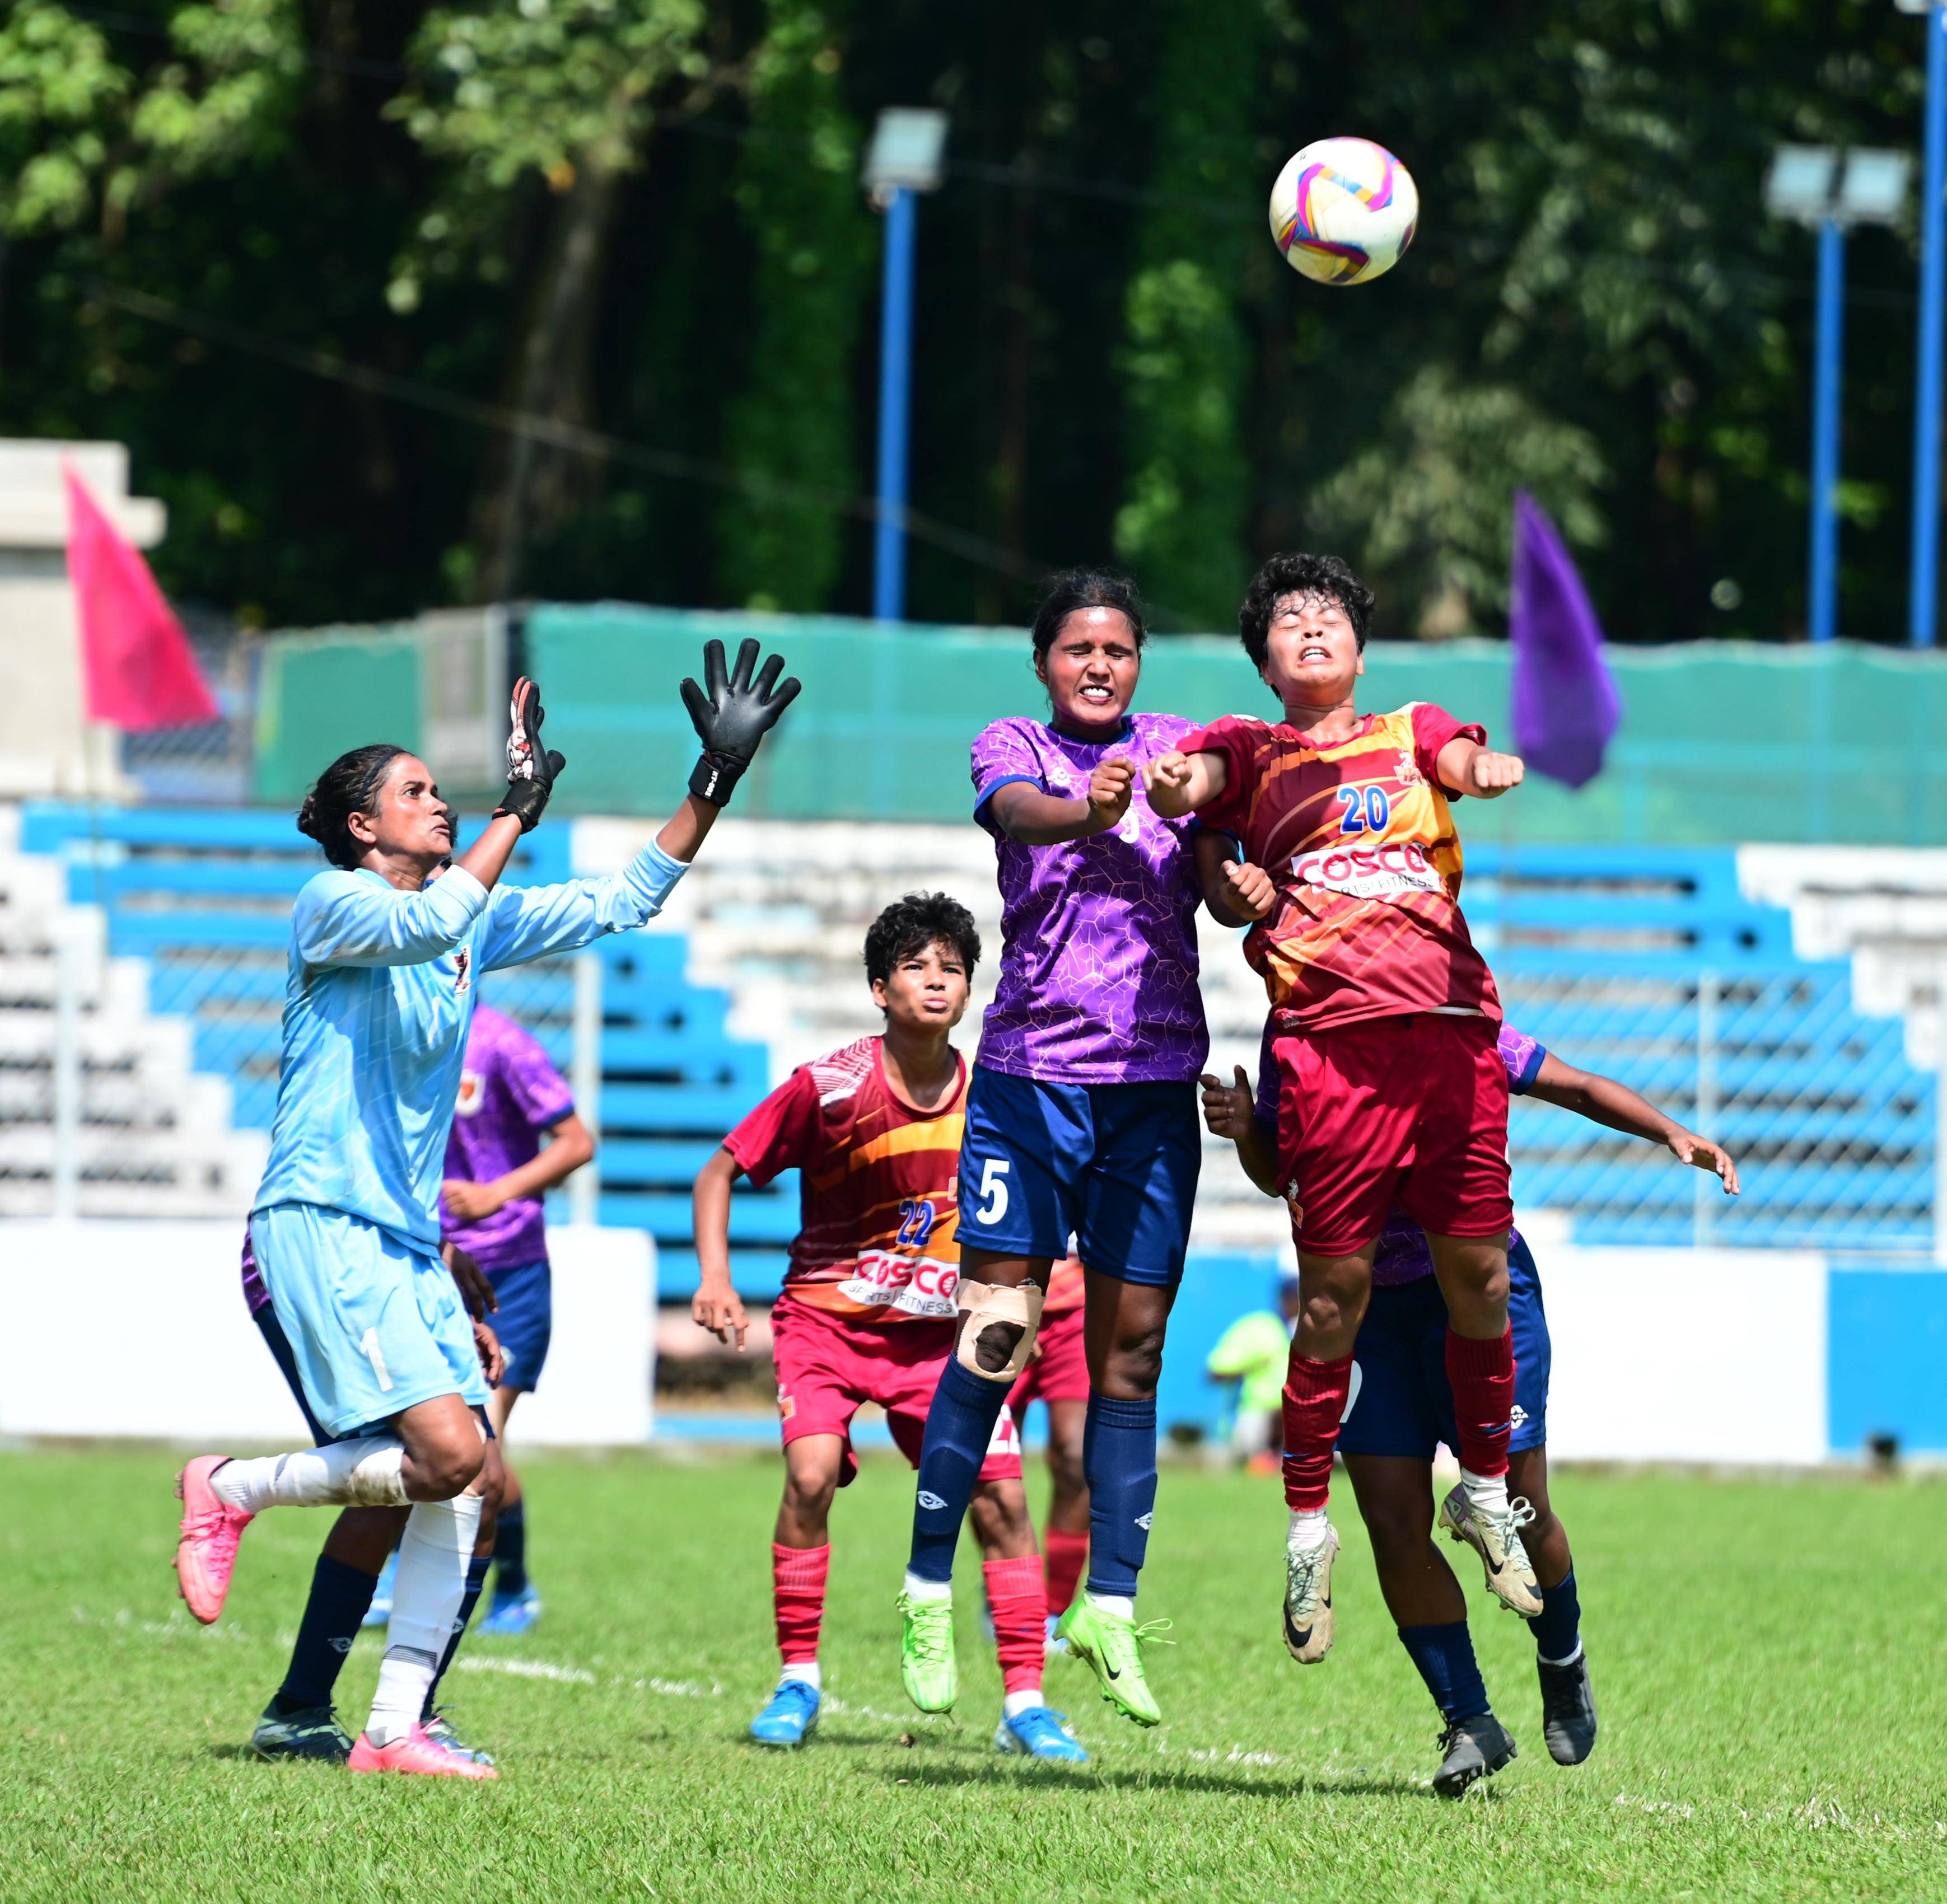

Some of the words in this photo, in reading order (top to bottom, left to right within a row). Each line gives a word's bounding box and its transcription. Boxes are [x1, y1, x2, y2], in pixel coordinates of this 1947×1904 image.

[1337, 785, 1389, 834] 20
[1297, 844, 1427, 887] COSCO
[976, 1158, 1010, 1224] 5
[897, 1200, 935, 1247] 22
[848, 1285, 890, 1302] SPRTS
[857, 1255, 958, 1298] COSCO
[359, 1326, 395, 1392] 1
